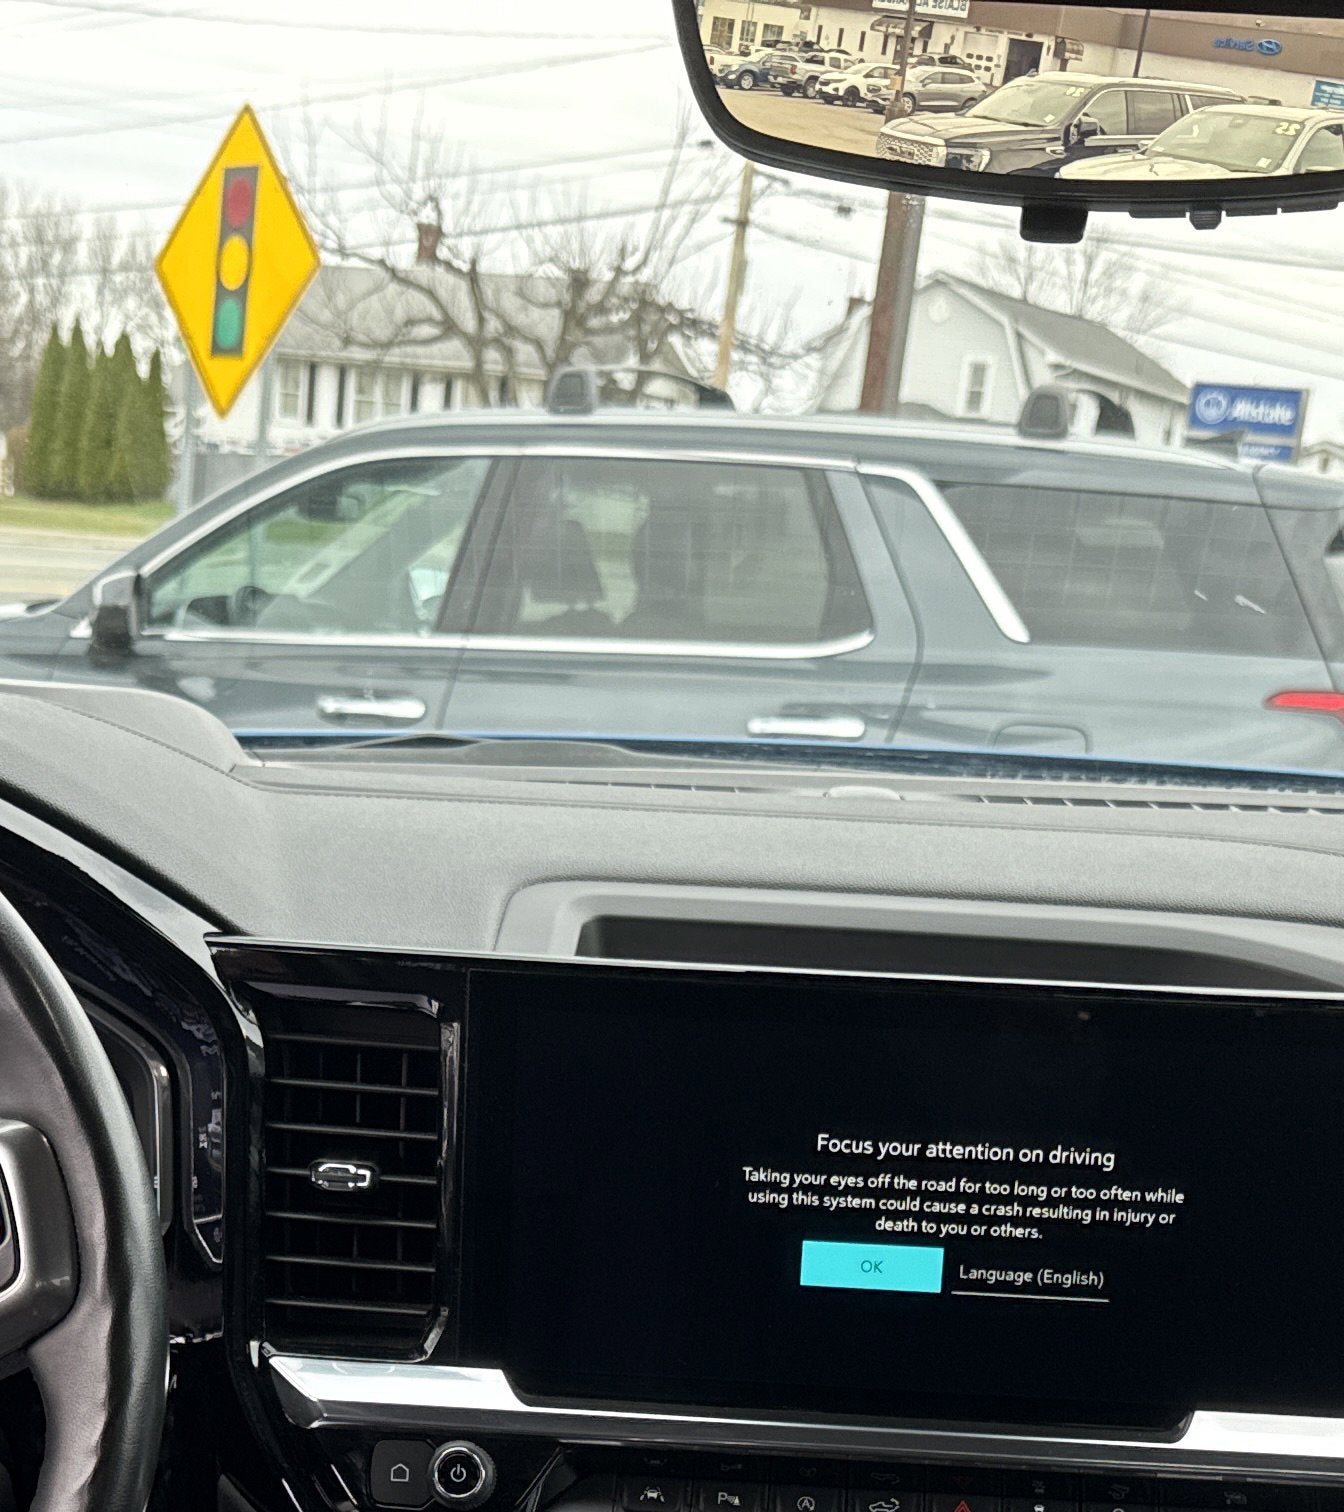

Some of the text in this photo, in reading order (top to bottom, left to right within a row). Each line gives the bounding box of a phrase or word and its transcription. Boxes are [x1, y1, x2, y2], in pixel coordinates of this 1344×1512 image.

[817, 1134, 1115, 1171] Focus your attention on driving
[743, 1167, 1184, 1203] Taking your eyes off the road for too long or too often while
[748, 1190, 1176, 1227] using this system could cause a crash resulting in injury or
[876, 1216, 1042, 1238] death to you or others.
[860, 1259, 884, 1274] OK
[960, 1265, 1103, 1289] Language (English)
